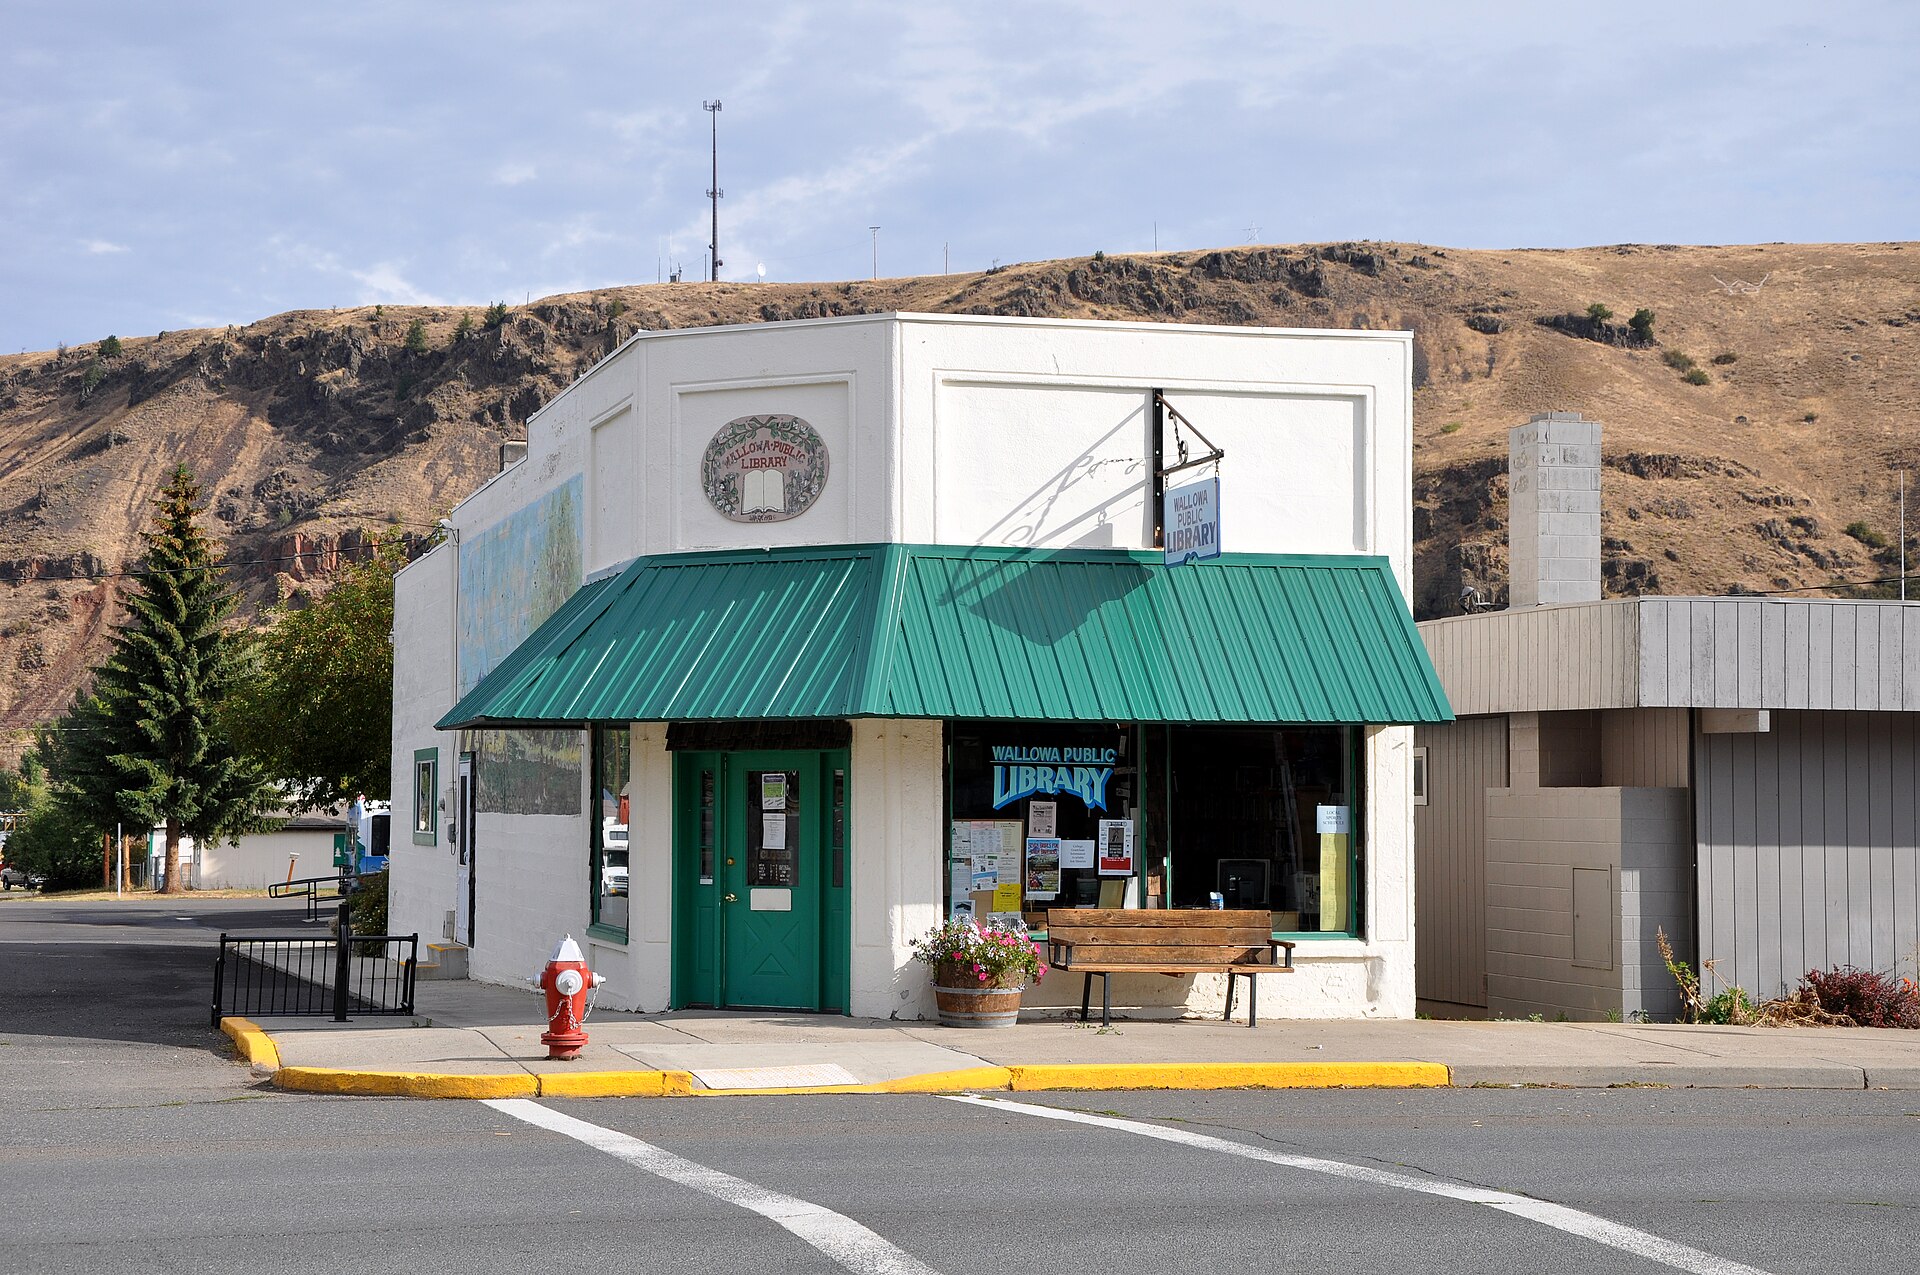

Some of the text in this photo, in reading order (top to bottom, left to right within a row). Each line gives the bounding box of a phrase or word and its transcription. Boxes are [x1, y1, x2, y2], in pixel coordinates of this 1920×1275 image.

[724, 440, 806, 468] WALLOWA PUBLIC
[741, 456, 787, 469] LIBRARY
[1173, 489, 1208, 513] WALLOWA
[1177, 508, 1203, 528] PUBLIC
[1166, 521, 1216, 554] LIBRARY
[991, 746, 1117, 762] WALLOWA PUBLIC
[992, 765, 1113, 812] LIBRARY
